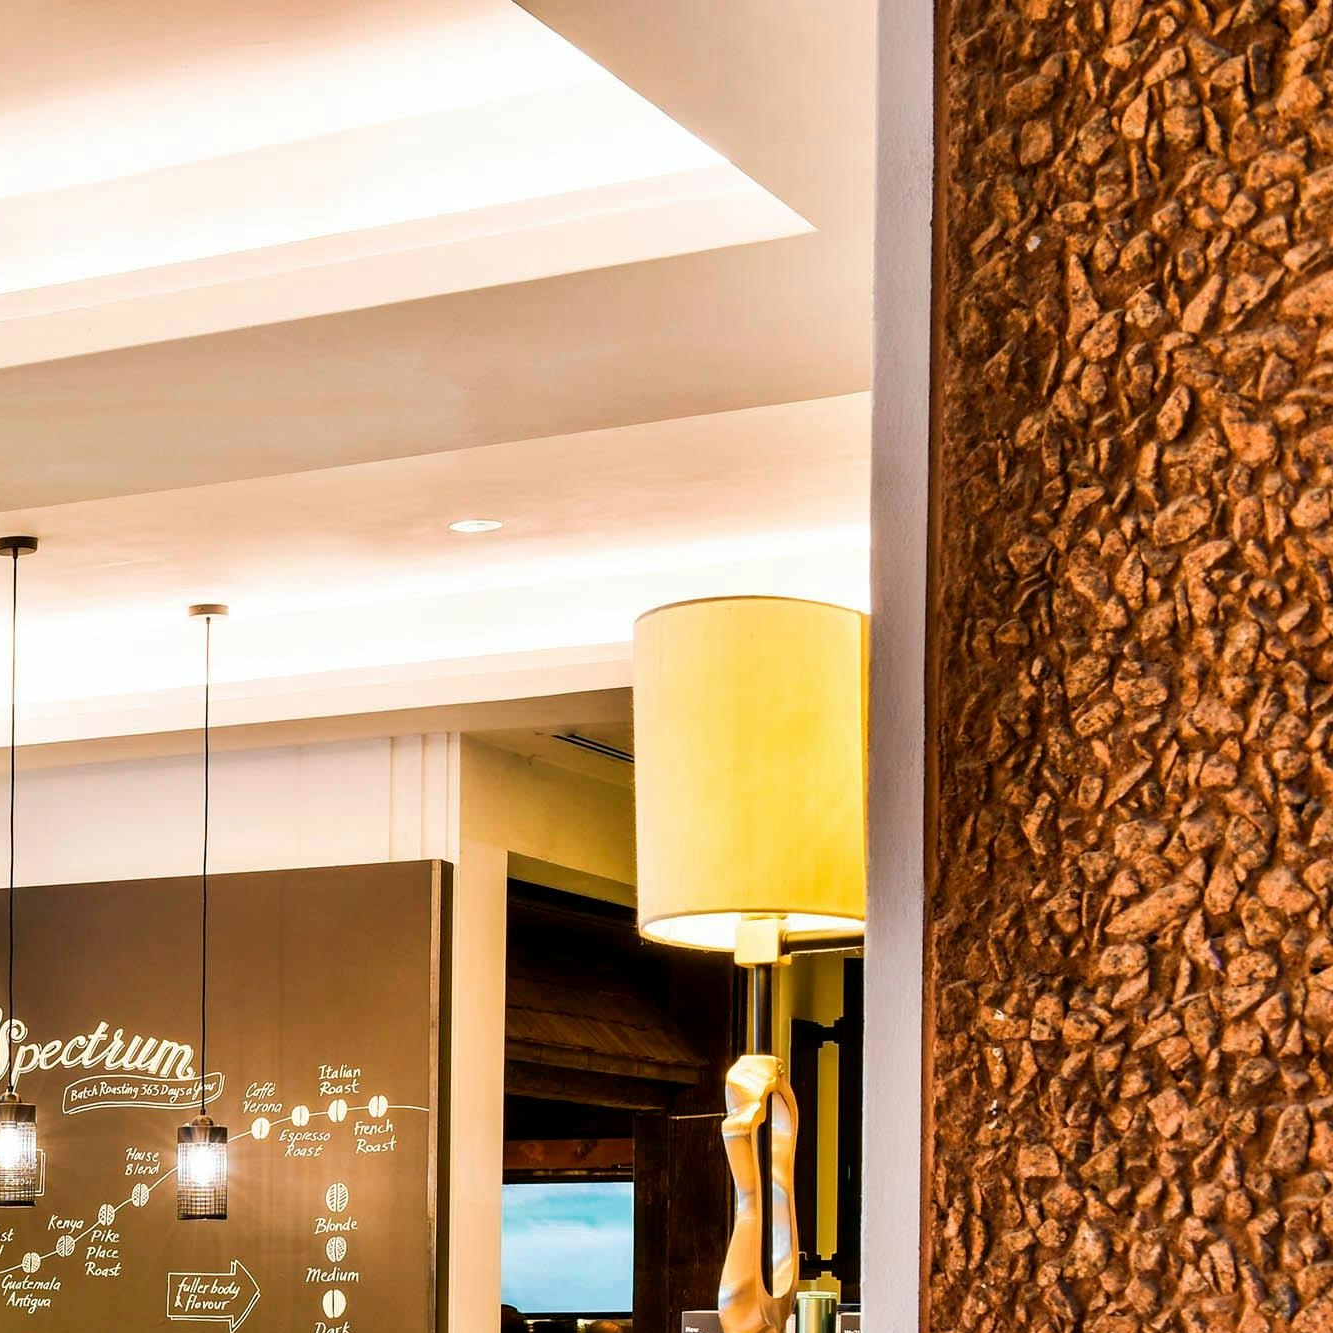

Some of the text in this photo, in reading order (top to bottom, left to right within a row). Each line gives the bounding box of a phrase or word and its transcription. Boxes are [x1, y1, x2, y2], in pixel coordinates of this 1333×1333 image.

[318, 1064, 361, 1080] Italian
[71, 1086, 98, 1101] Batch
[99, 1081, 139, 1099] Roasting
[141, 1084, 159, 1096] 363
[160, 1084, 185, 1103] Days
[319, 1079, 360, 1096] Roast
[242, 1101, 283, 1114] Verona
[354, 1119, 393, 1136] French
[278, 1129, 331, 1145] Espresso
[356, 1135, 397, 1154] Roast
[125, 1147, 159, 1162] House
[284, 1145, 323, 1158] Roast
[125, 1162, 160, 1176] Blend
[48, 1215, 84, 1233] Kenya
[314, 1216, 358, 1234] Blonde
[90, 1230, 120, 1243] Pike
[85, 1247, 119, 1260] Place
[85, 1261, 121, 1277] Roast
[305, 1266, 359, 1283] Medium
[1, 1275, 61, 1296] Guatemala
[177, 1277, 241, 1299] fuller body
[6, 1291, 51, 1314] Antigua
[185, 1294, 230, 1312] flavour
